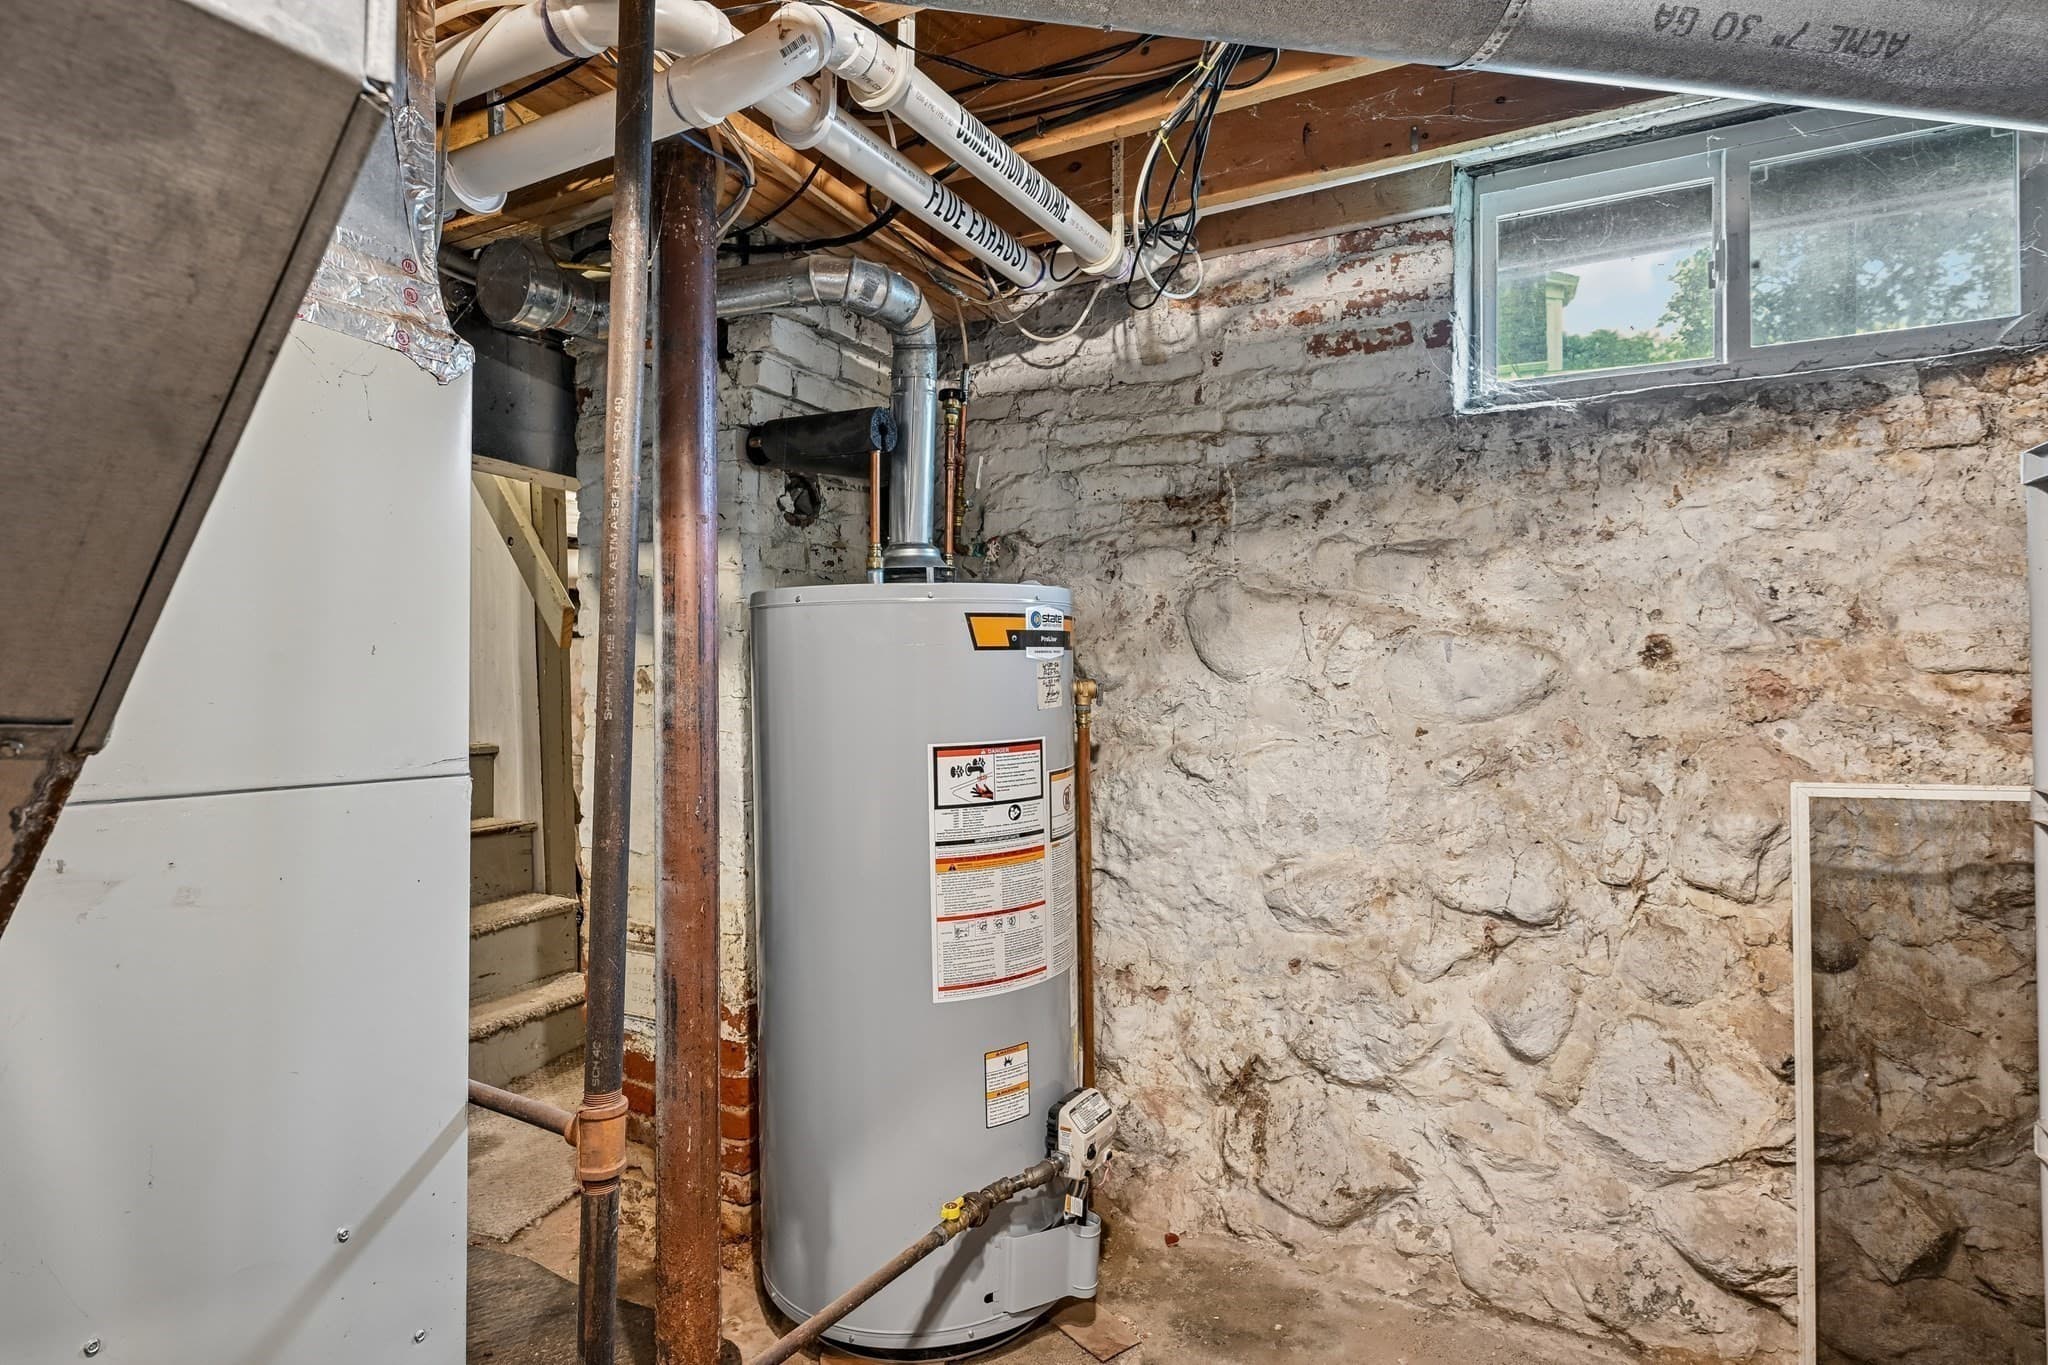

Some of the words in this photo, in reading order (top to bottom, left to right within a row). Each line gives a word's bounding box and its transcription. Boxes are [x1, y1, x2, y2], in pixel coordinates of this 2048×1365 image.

[1654, 3, 1699, 37] GA
[1712, 11, 1762, 41] 30
[1769, 21, 1810, 49] 7"
[1829, 25, 1910, 59] ACME
[957, 106, 1024, 187] COMBUSTION
[1021, 163, 1041, 200] AIR
[1037, 175, 1069, 224] INTAKE
[924, 177, 966, 230] FLUE
[965, 206, 1028, 272] EXHAUST
[614, 396, 624, 413] 40
[1041, 613, 1063, 624] state
